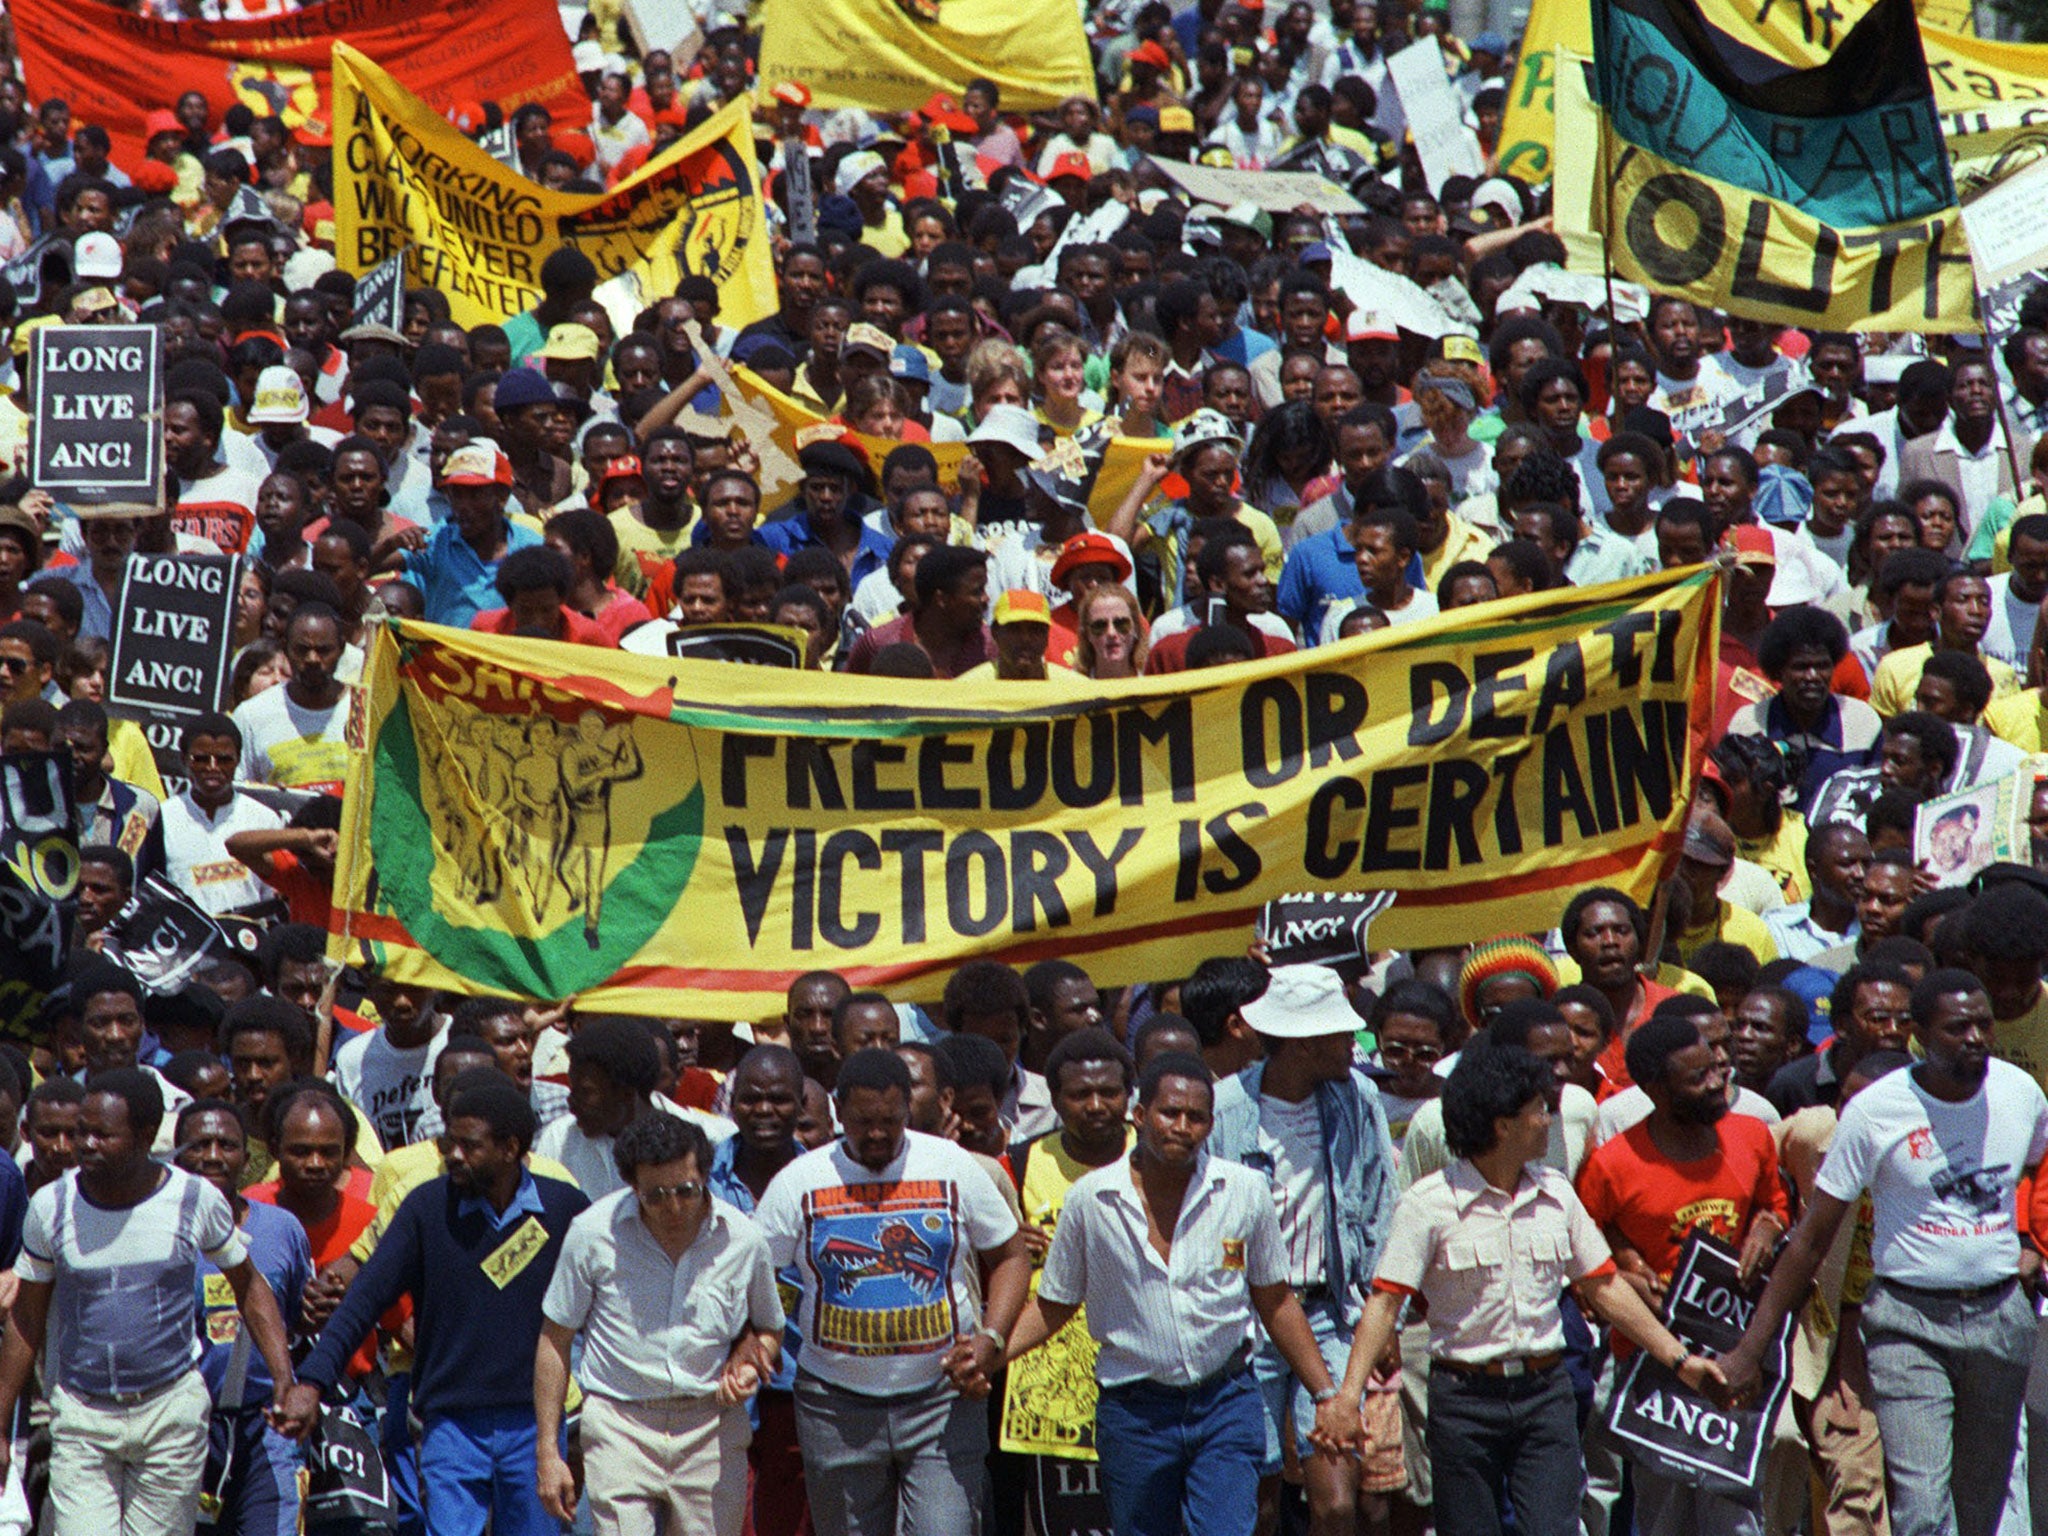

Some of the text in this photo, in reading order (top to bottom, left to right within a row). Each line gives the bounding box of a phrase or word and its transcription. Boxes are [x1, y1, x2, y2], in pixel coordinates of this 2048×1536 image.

[381, 113, 542, 214] ORKING
[434, 186, 543, 247] UNITED
[46, 346, 144, 373] LONG
[52, 395, 134, 421] LIVE
[50, 443, 131, 469] ANC!
[133, 555, 224, 594] LONG
[132, 607, 211, 644] LIVE
[125, 658, 203, 695] ANC!
[721, 696, 1196, 811] FREEDOM
[1240, 672, 1369, 790] OR
[723, 826, 1146, 950] VICTORY
[1174, 801, 1269, 902] IS
[1682, 1272, 1755, 1331] LON
[1009, 1416, 1081, 1445] BUILD
[1635, 1389, 1739, 1452] ANC!
[309, 1440, 366, 1479] NC!
[1056, 1463, 1102, 1495] LI
